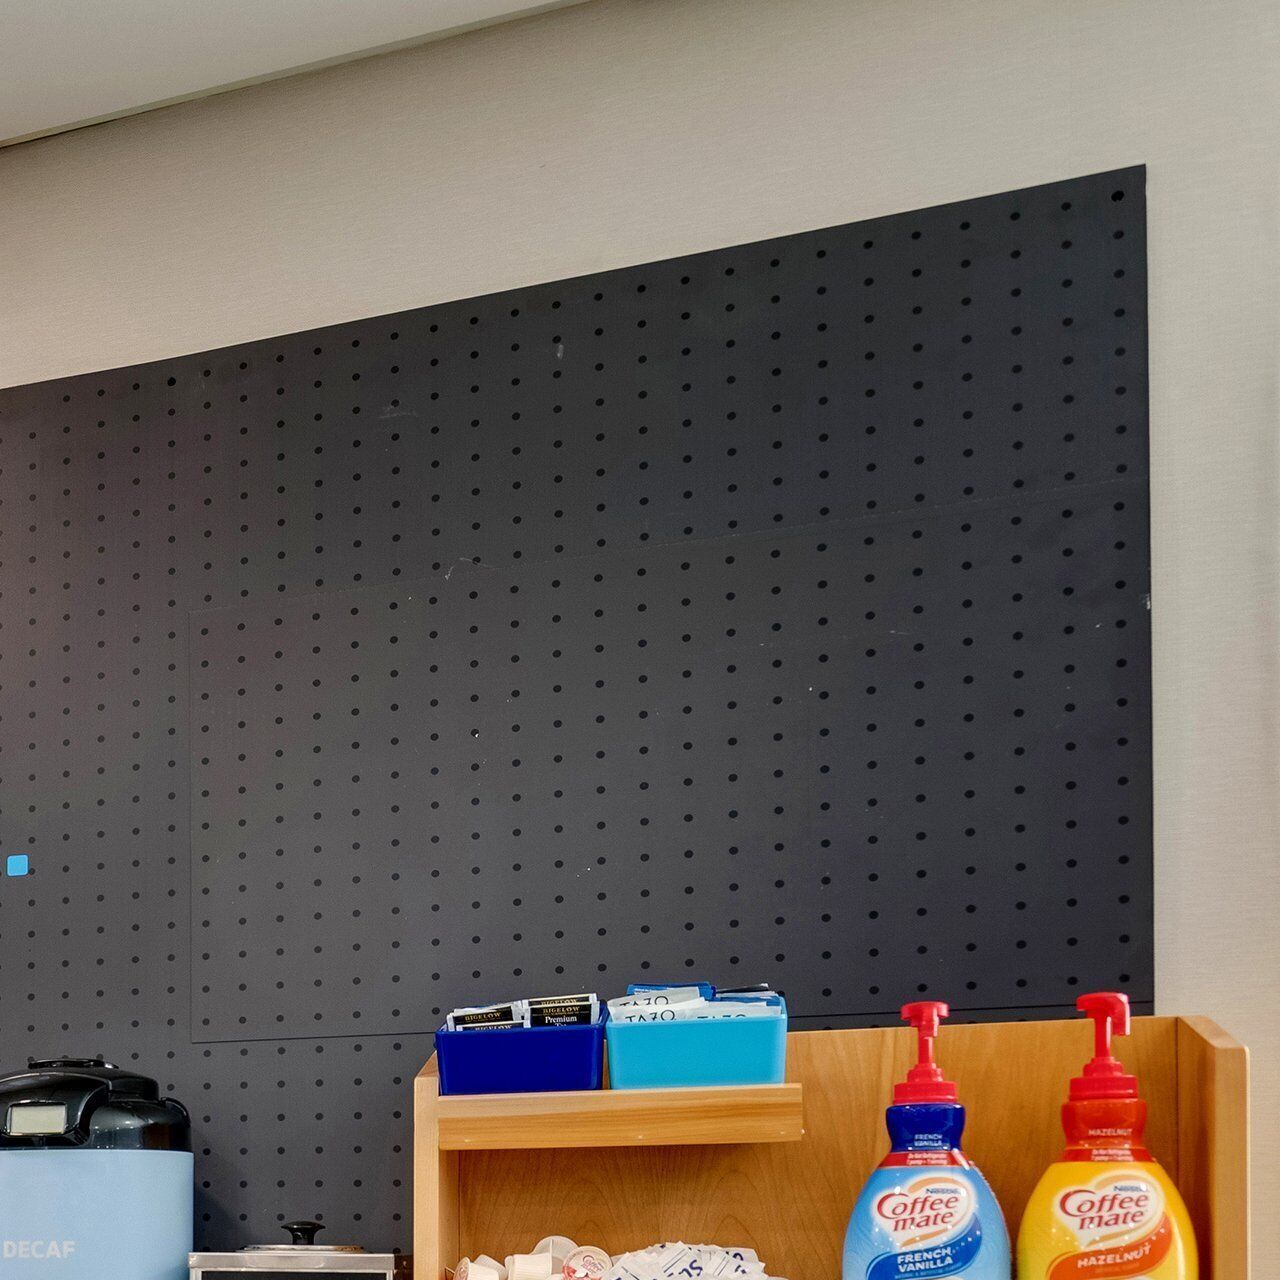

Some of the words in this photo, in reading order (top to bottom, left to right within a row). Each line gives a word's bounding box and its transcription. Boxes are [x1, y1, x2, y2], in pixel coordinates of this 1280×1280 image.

[465, 1012, 502, 1021] BIGELOW
[542, 1006, 580, 1014] BIGELOW
[544, 1015, 577, 1024] Premium
[1088, 1128, 1132, 1136] HAZELNUT
[877, 1192, 958, 1220] Coffee
[1059, 1189, 1149, 1217] Coffee
[893, 1212, 954, 1232] mate
[1078, 1210, 1144, 1230] mate
[2, 1240, 76, 1259] DECAF
[897, 1246, 952, 1264] FRENCH
[1077, 1244, 1151, 1268] HAZELNUT
[898, 1256, 953, 1273] VANILLA
